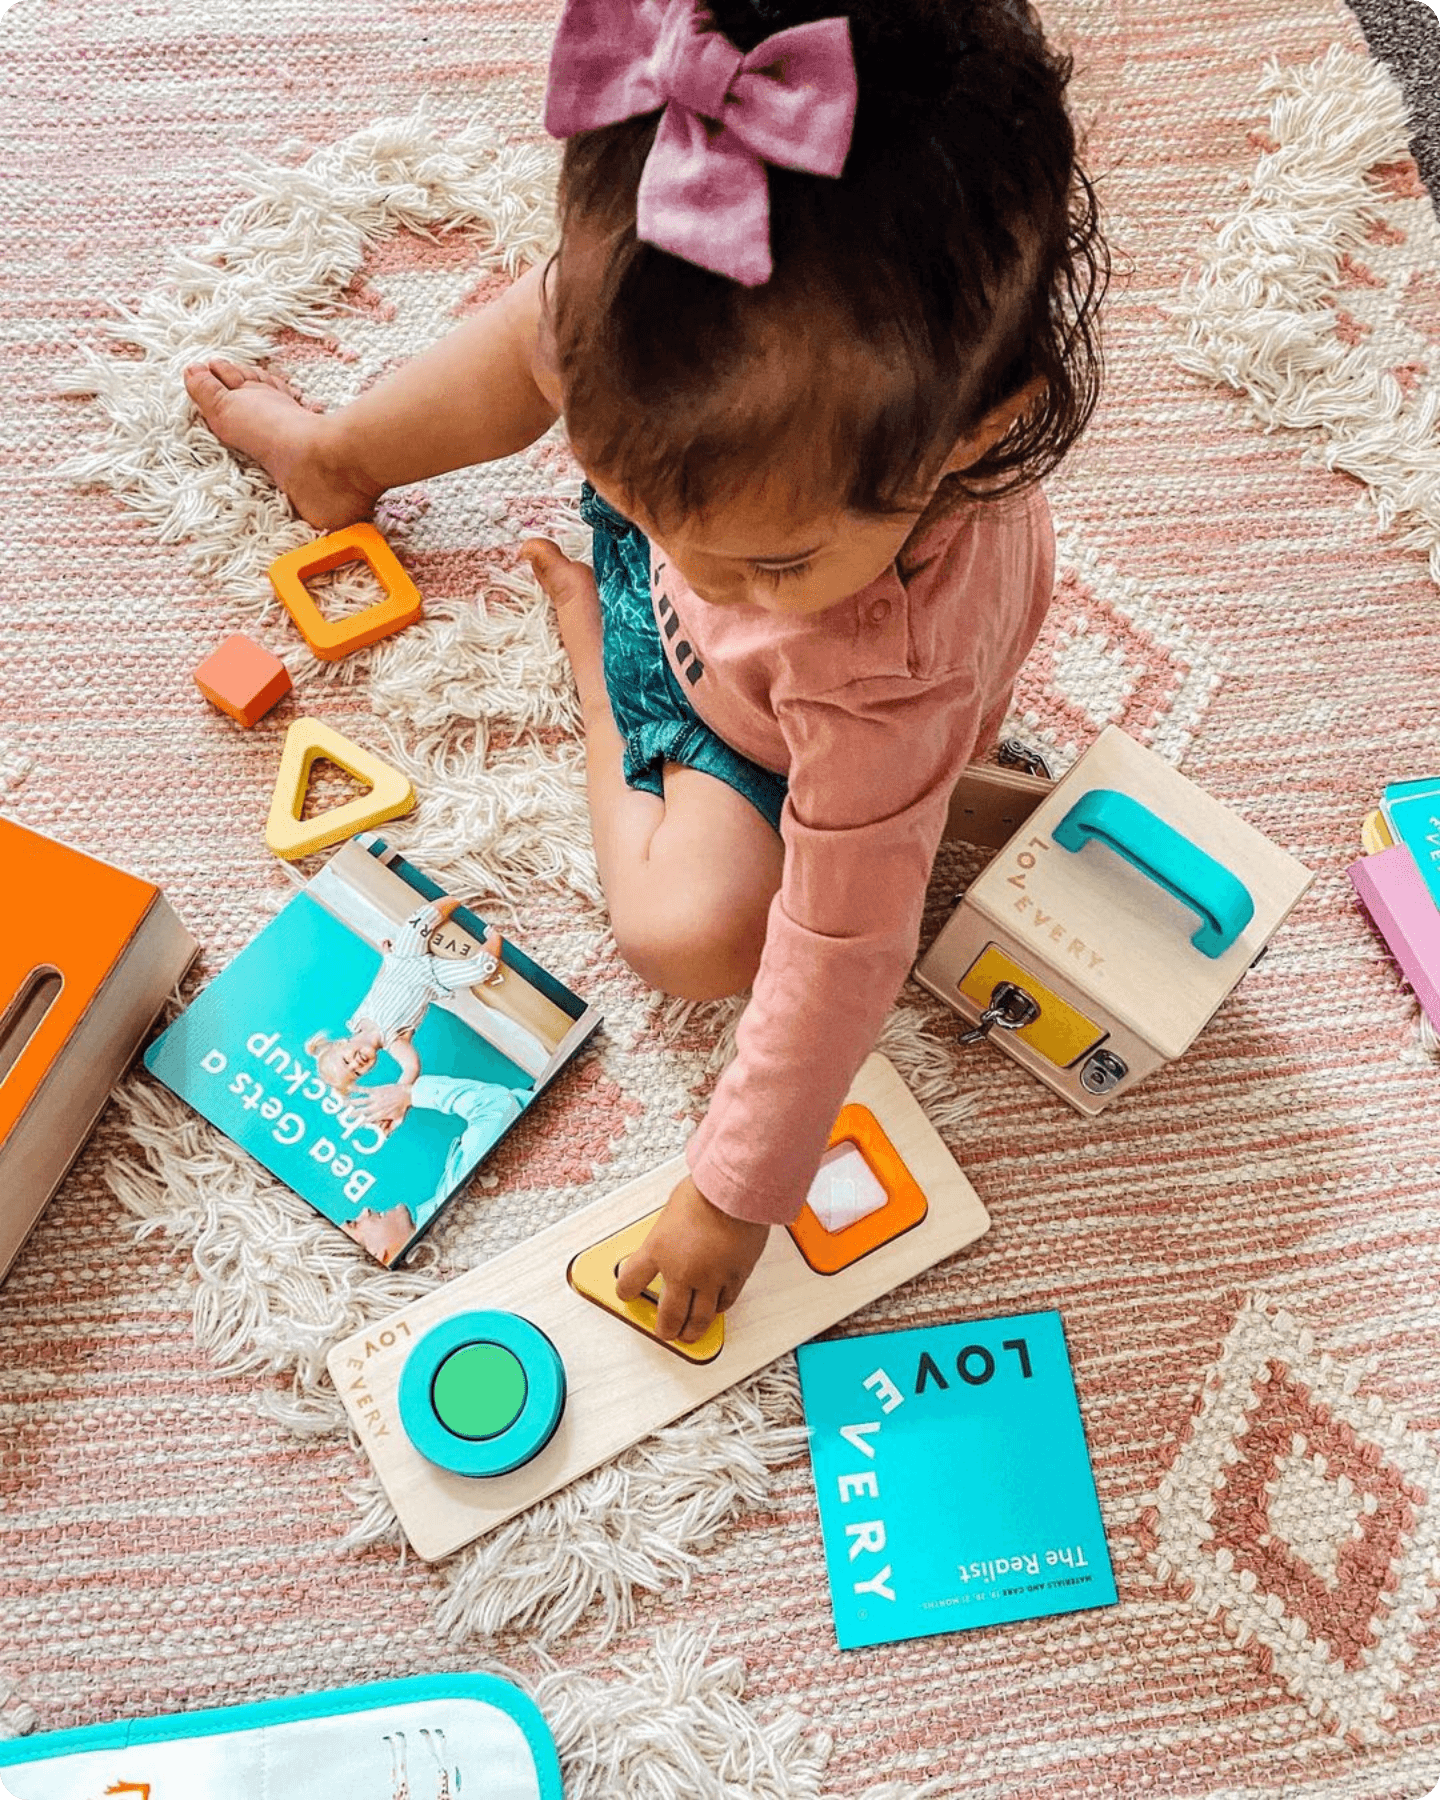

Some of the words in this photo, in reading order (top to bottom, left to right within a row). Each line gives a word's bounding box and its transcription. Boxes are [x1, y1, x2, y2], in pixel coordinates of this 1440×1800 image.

[200, 1048, 228, 1075] a
[228, 1072, 306, 1145] Gets
[246, 1032, 386, 1155] Checkup
[308, 1136, 377, 1204] Bea
[958, 1552, 1040, 1584] Realist
[1045, 1545, 1089, 1569] The
